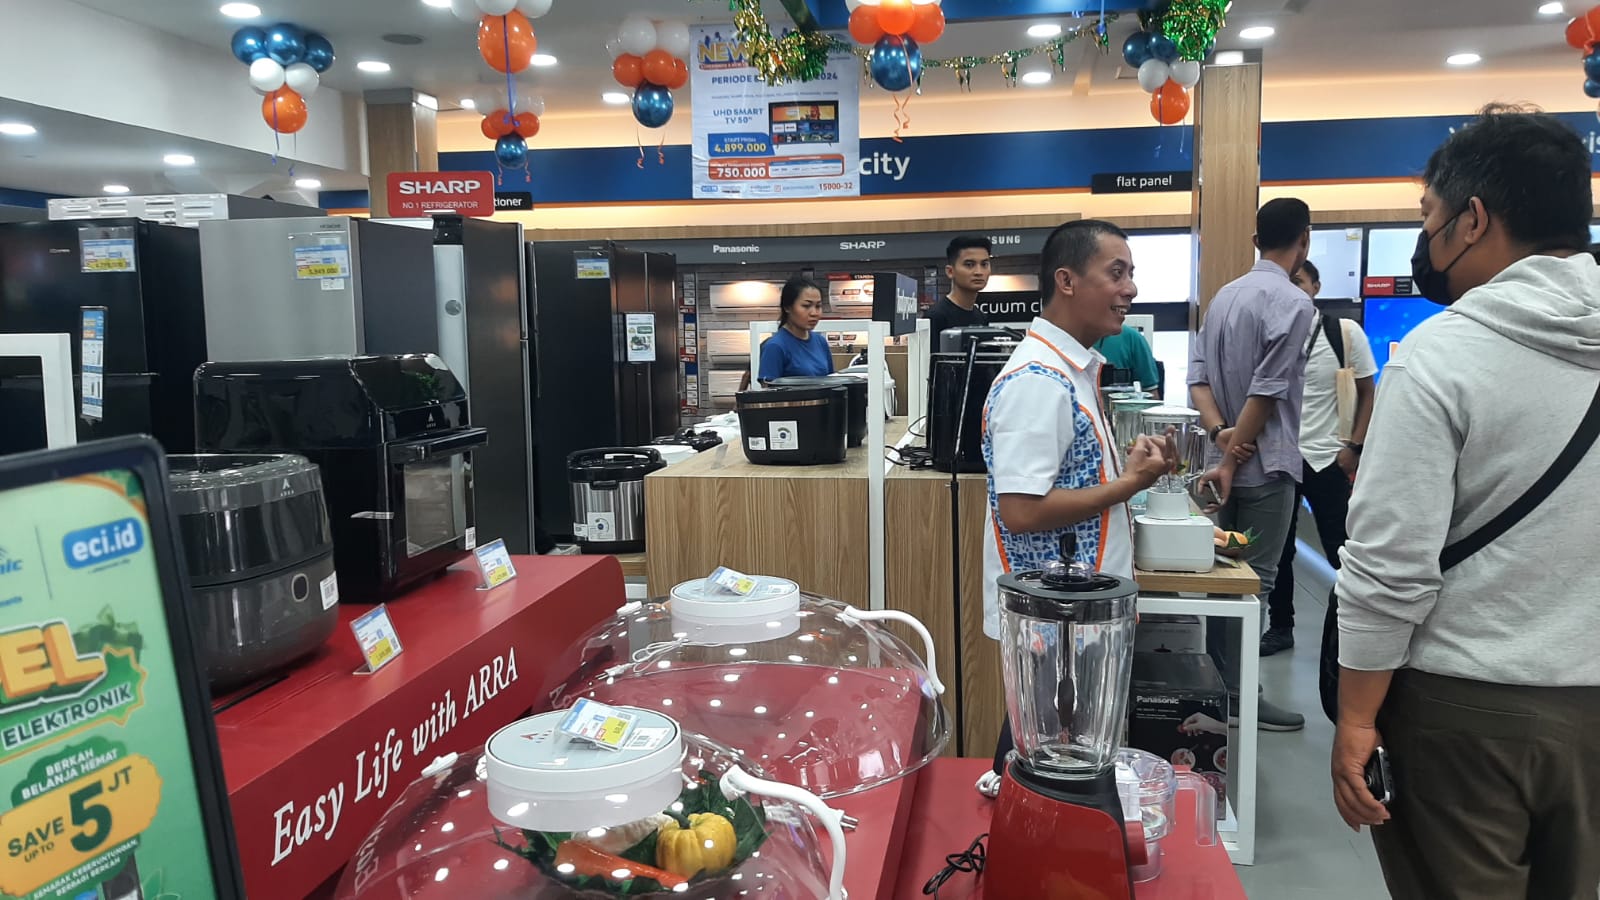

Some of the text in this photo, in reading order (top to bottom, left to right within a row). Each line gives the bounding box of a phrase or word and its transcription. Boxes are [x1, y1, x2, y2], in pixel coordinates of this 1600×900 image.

[711, 74, 753, 85] PERIODE
[713, 107, 764, 117] UHD SMART
[714, 143, 767, 153] 4.899.000
[716, 167, 766, 178] 750.000
[859, 151, 911, 181] city
[399, 180, 481, 195] SHARP
[1116, 174, 1172, 189] flat panel
[421, 201, 479, 209] REFRIGERATOR
[839, 240, 887, 251] SHARP
[988, 235, 1021, 245] SUNG
[712, 244, 760, 254] Panasonic
[71, 522, 137, 562] eci.id
[0, 622, 107, 699] EL
[1136, 695, 1180, 705] Panasonic
[2, 683, 133, 748] ELEKTRONIK
[46, 749, 94, 776] BERKAH
[271, 781, 344, 866] Easy
[354, 728, 403, 804] Life
[411, 689, 458, 756] with
[462, 646, 519, 720] ARRA
[21, 749, 118, 800] BELANJA HEMAT
[69, 765, 133, 853] 5 JT
[7, 816, 65, 858] SAVE
[24, 841, 55, 863] UP TO
